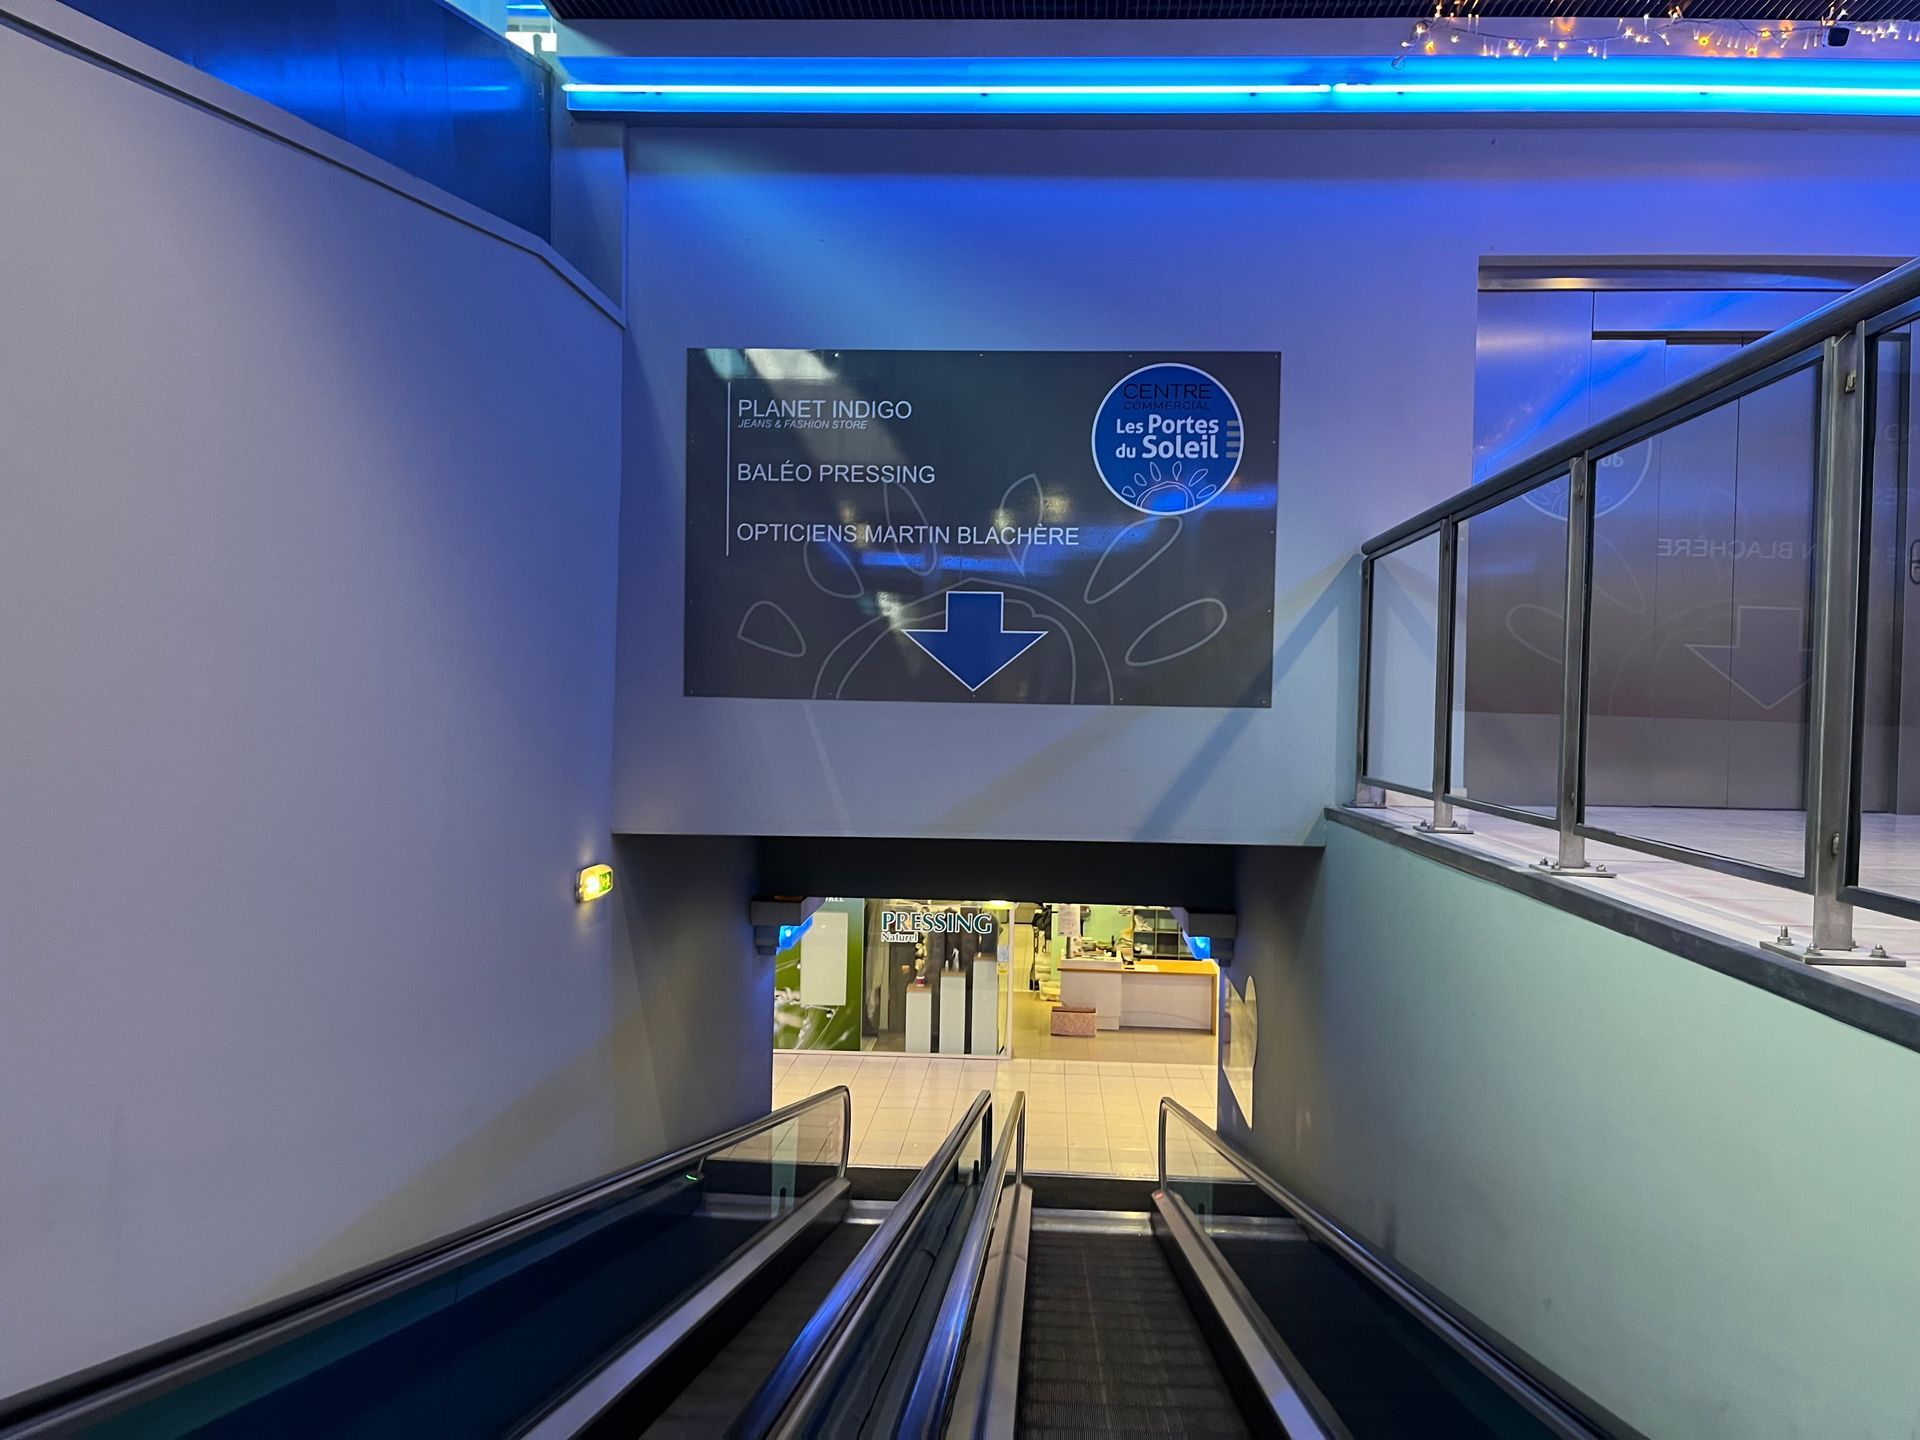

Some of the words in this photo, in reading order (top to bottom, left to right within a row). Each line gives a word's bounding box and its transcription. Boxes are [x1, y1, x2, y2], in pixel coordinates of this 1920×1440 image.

[1123, 383, 1211, 399] CENTRE
[738, 399, 827, 418] PLANET
[832, 400, 913, 420] INDIGO
[1123, 401, 1211, 411] COMMERCIAL
[738, 419, 772, 429] JEANS
[774, 419, 782, 429] &
[784, 419, 829, 430] FASHION
[832, 420, 868, 430] STORE
[1116, 418, 1144, 435] Les
[1148, 414, 1219, 434] Portes
[1115, 443, 1136, 459] du
[1142, 434, 1219, 459] Soleil
[737, 460, 812, 482] BALÉO
[819, 465, 936, 484] PRESSING
[736, 523, 858, 543] OPTICIENS
[864, 525, 950, 544] MARTIN
[957, 523, 1079, 546] BLACHÈRE
[881, 911, 993, 934] PRESSING
[881, 931, 919, 943] Naturel
